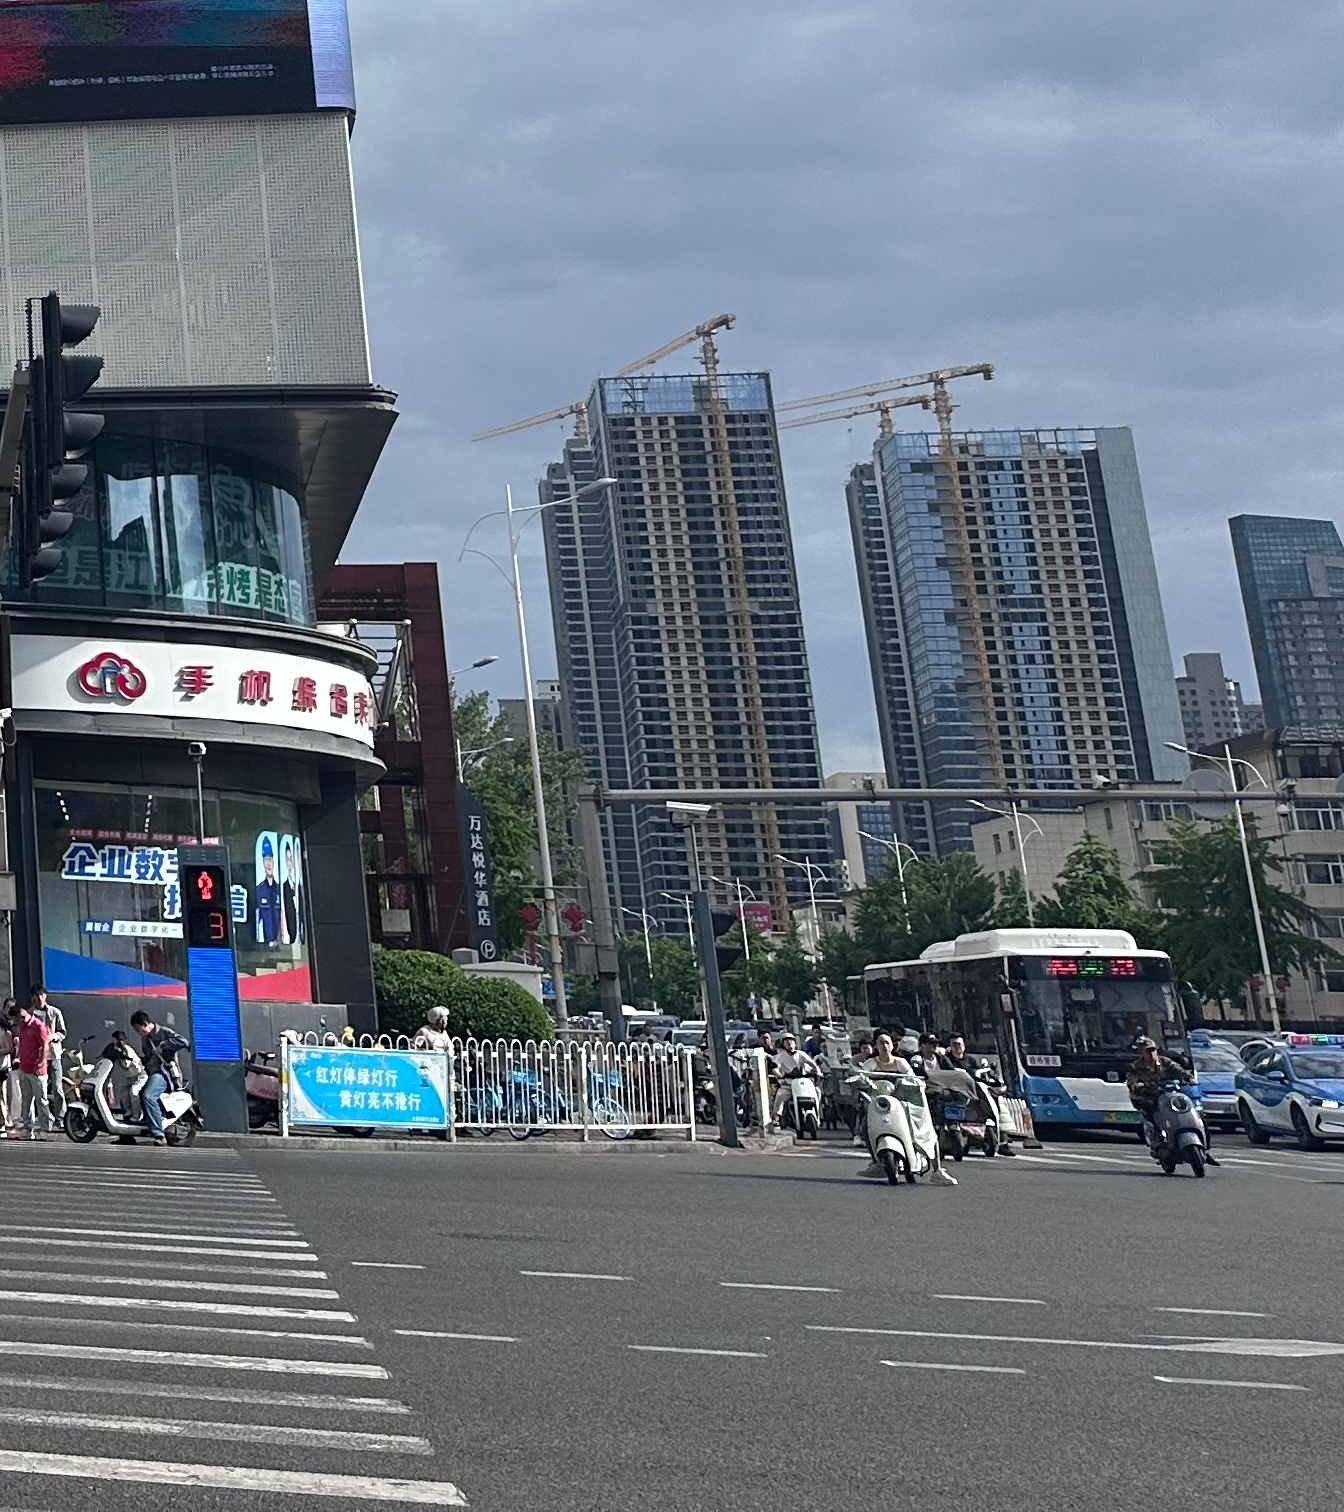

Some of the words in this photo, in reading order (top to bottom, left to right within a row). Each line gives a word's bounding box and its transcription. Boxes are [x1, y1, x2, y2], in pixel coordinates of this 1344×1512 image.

[468, 815, 491, 926] 万达悦华酒店
[208, 913, 224, 939] 3
[315, 1065, 399, 1088] 红灯停绿灯行
[338, 1090, 422, 1112] 黄灯亮不抢行
